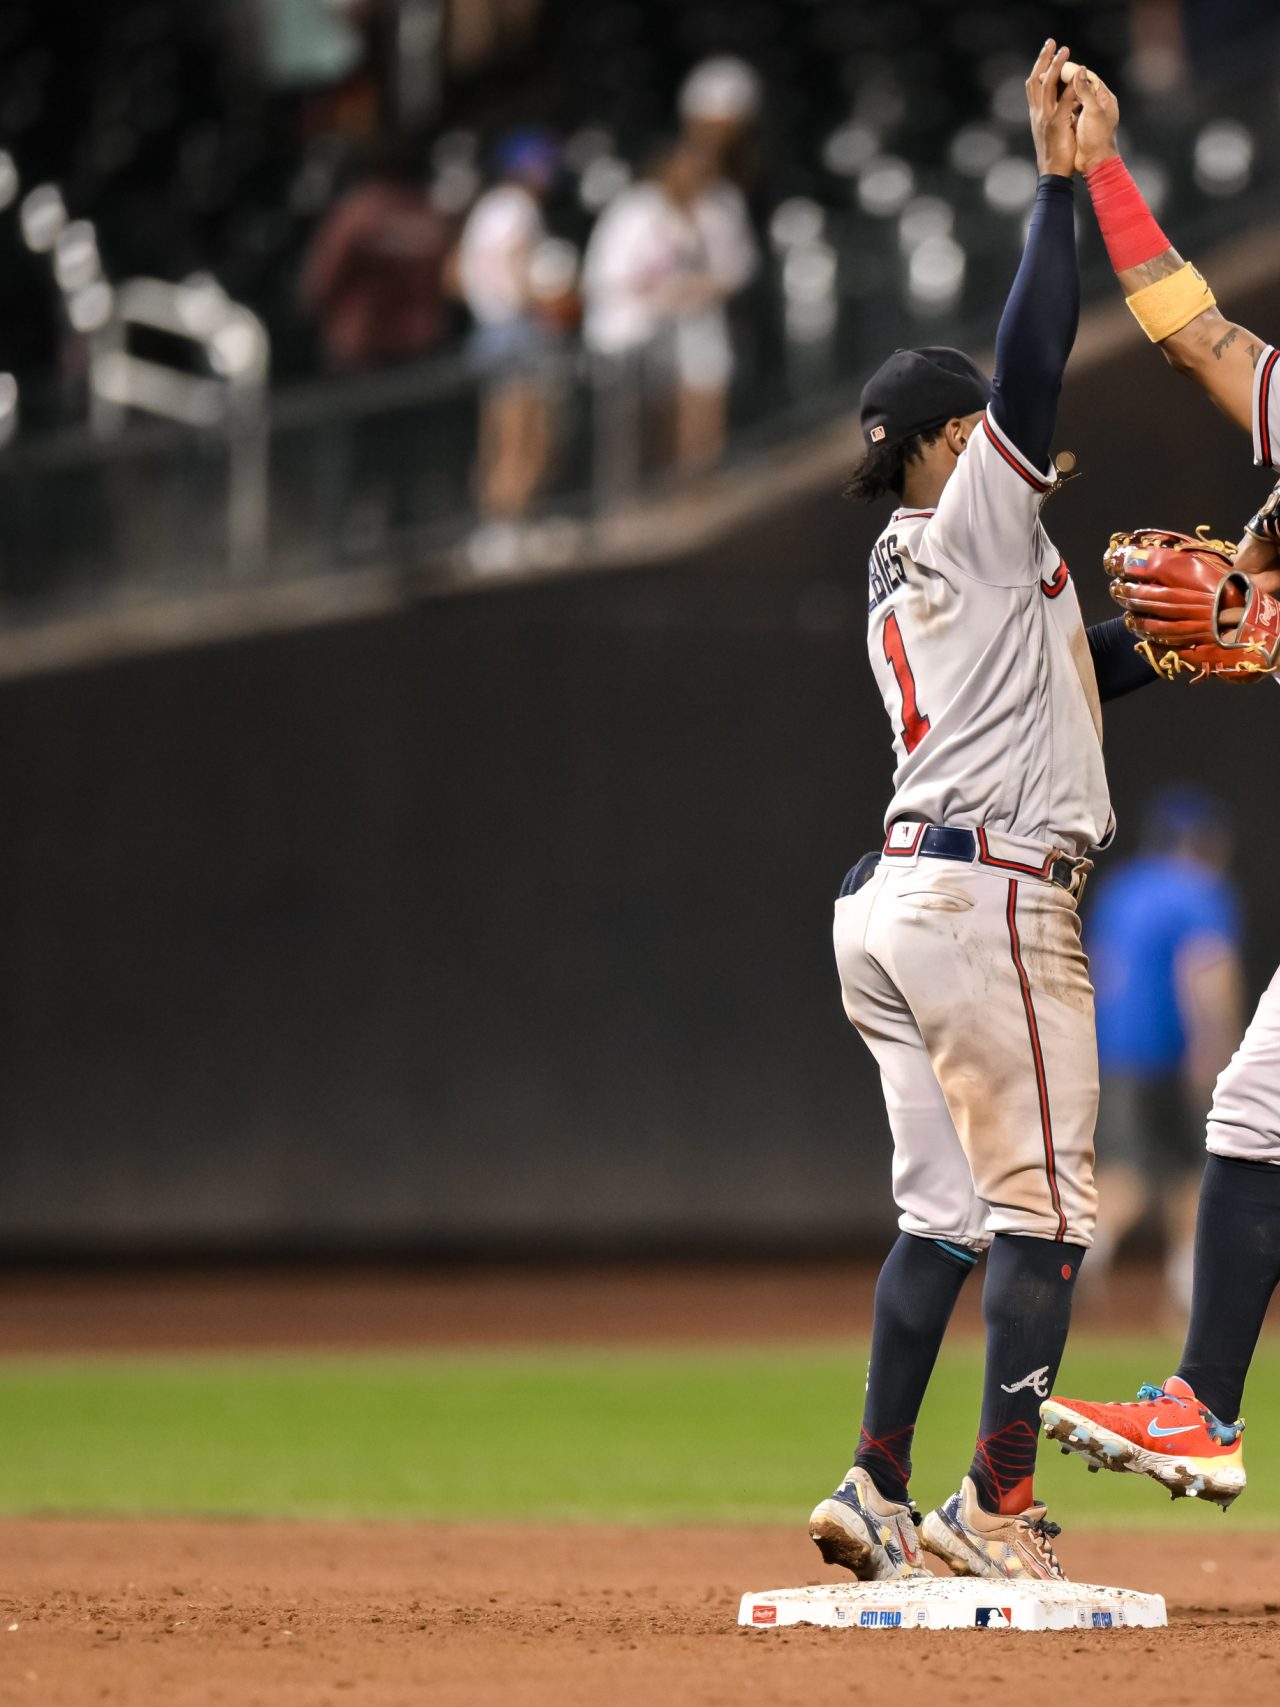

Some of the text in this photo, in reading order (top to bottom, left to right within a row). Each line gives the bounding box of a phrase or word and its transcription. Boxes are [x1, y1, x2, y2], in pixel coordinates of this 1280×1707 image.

[882, 610, 931, 756] 1
[860, 1610, 902, 1626] CITI FIELD
